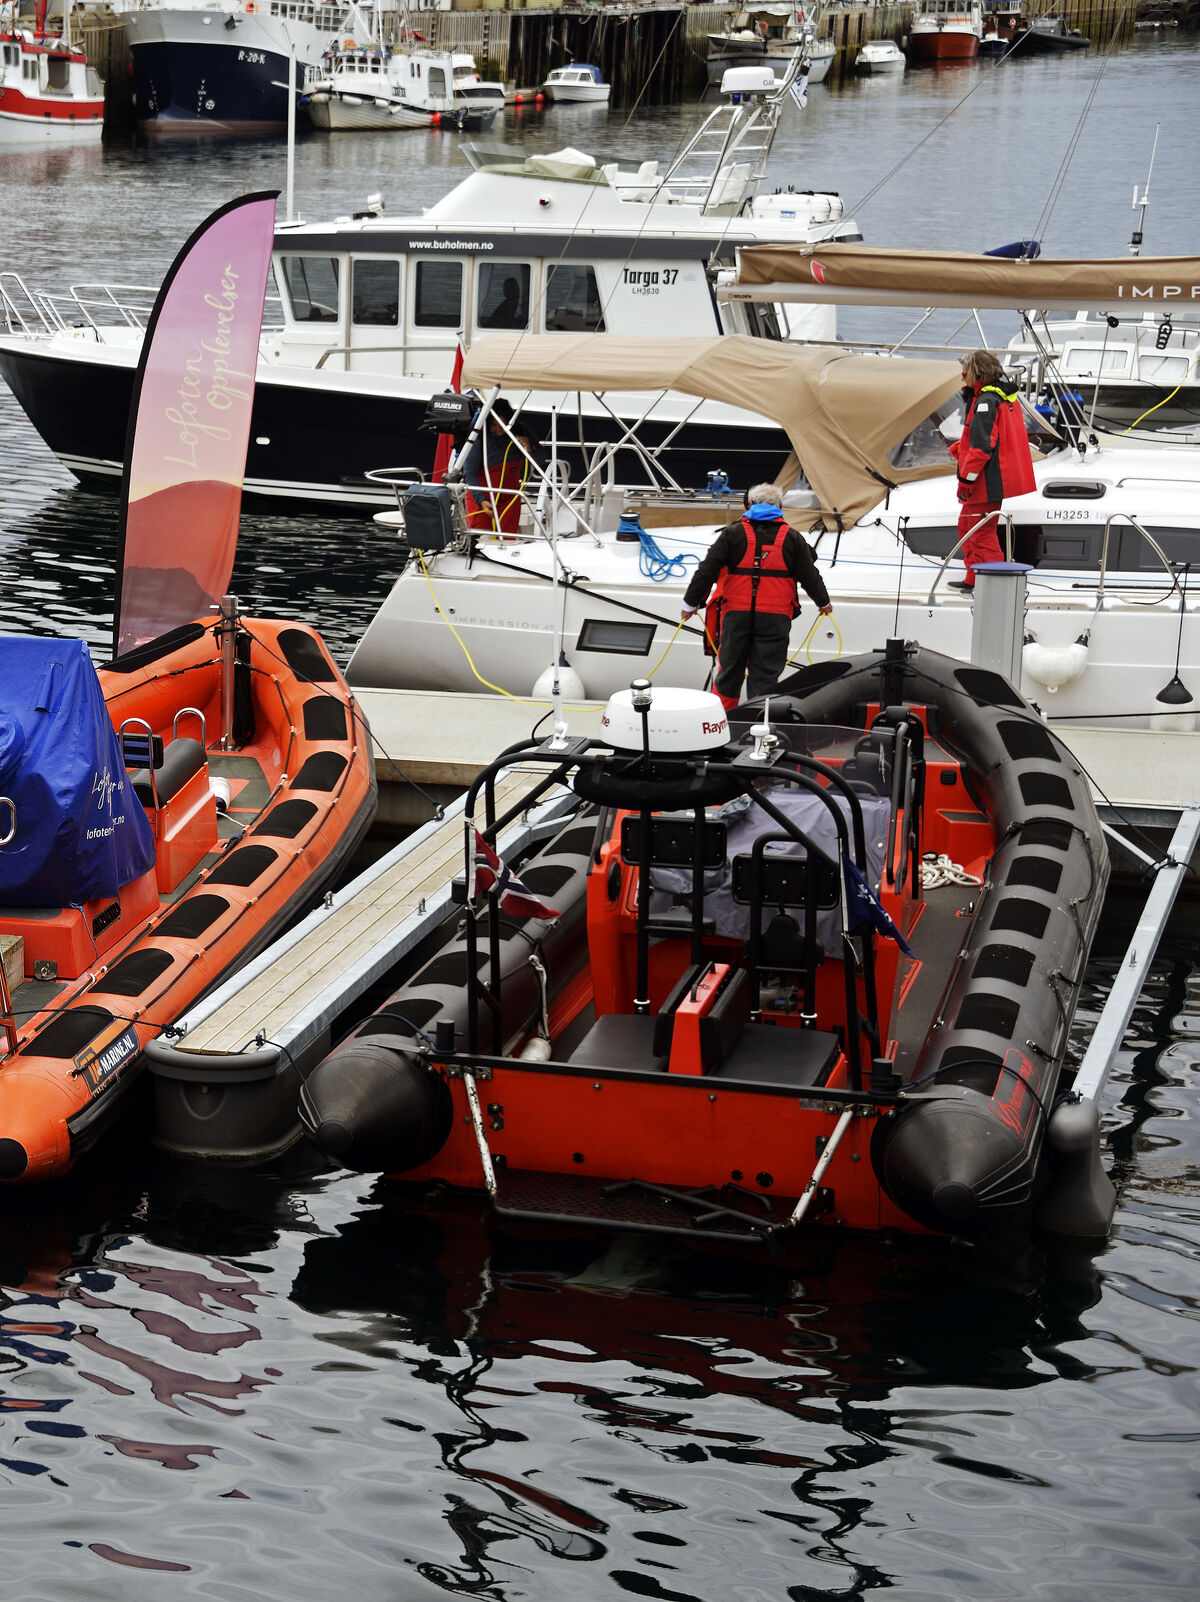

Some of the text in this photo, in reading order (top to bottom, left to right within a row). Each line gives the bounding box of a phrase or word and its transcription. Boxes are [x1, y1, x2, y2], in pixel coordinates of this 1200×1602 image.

[408, 239, 494, 250] www.buholmen.no
[623, 268, 679, 287] Targa 37
[433, 401, 462, 411] SUZUKI
[1046, 510, 1090, 520] LH3253
